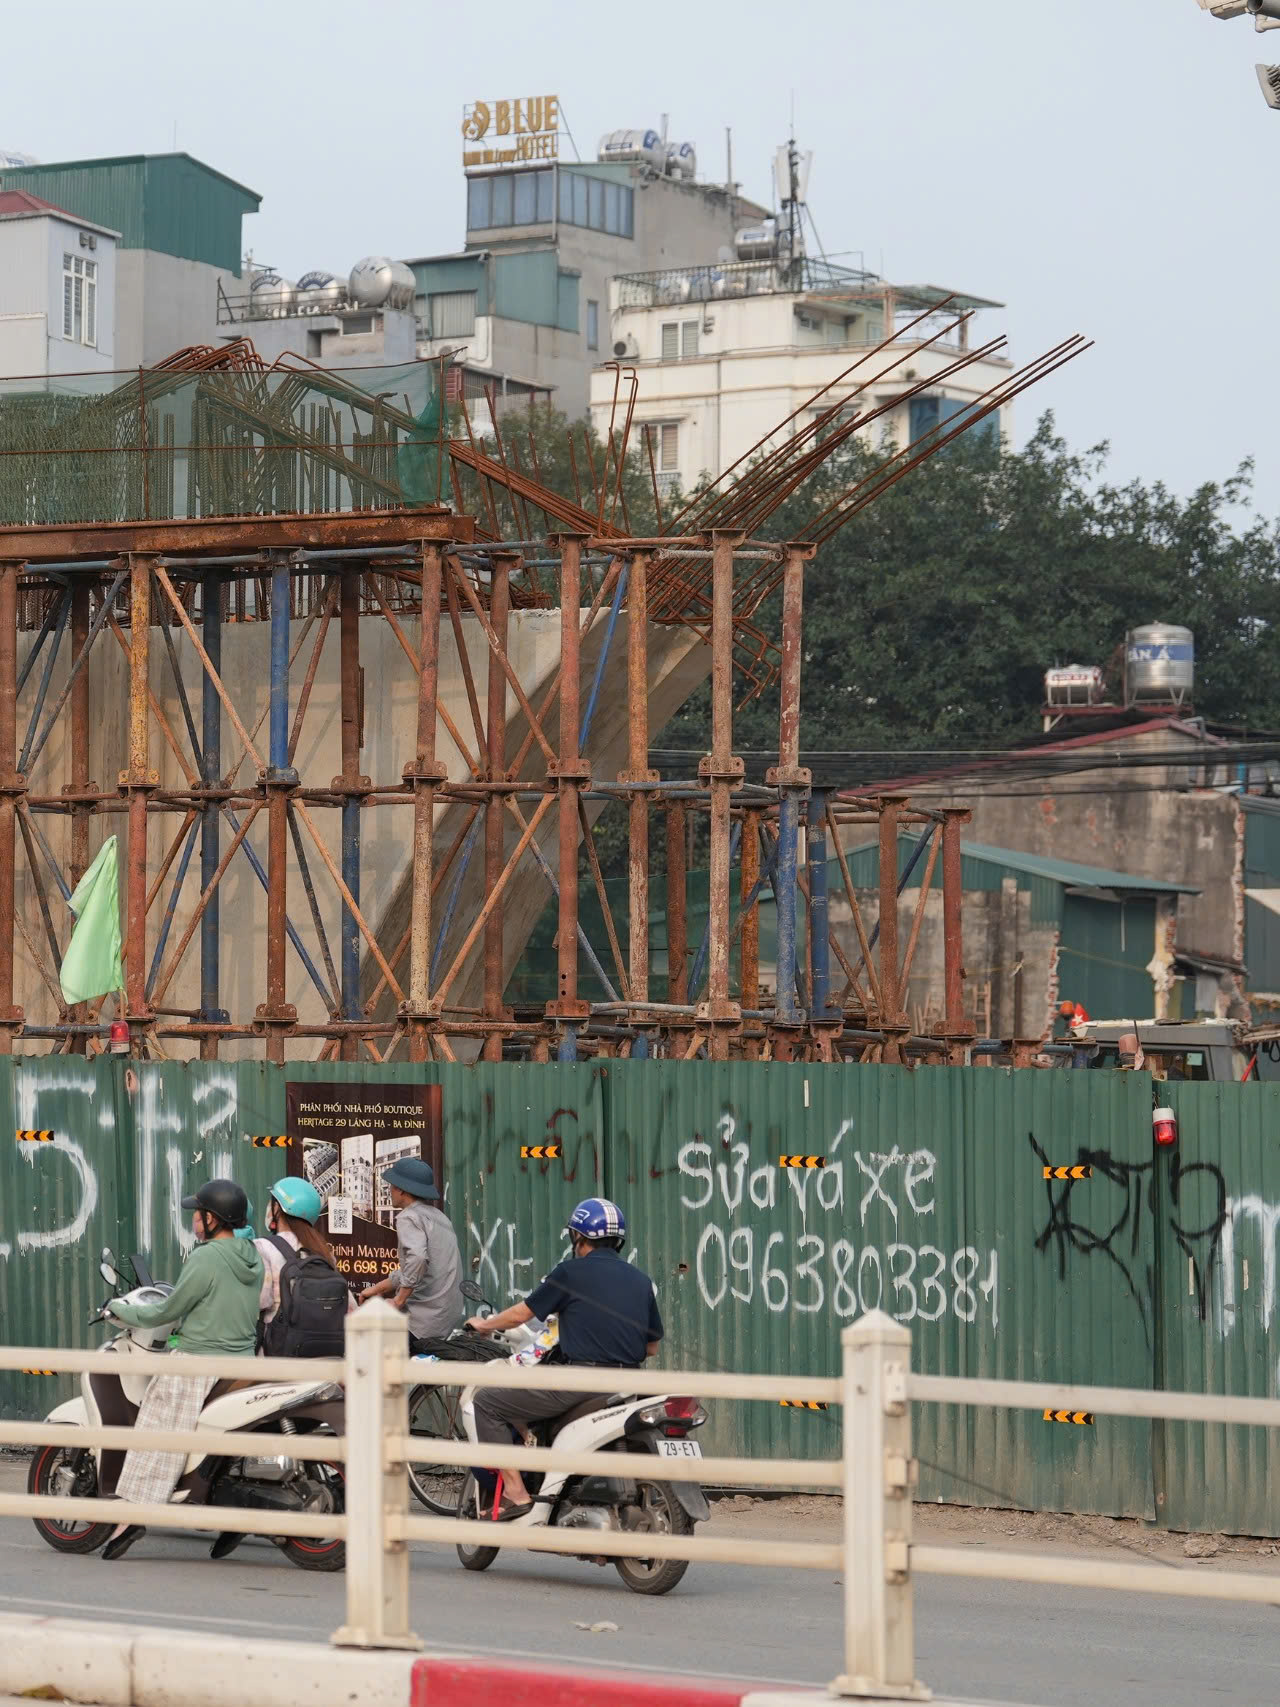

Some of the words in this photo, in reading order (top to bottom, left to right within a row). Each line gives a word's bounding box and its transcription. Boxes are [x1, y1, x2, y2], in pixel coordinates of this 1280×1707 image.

[496, 95, 557, 135] BLUE
[300, 1102, 321, 1112] PHÂN
[323, 1102, 342, 1113] PHỐI
[344, 1103, 362, 1113] NHÀ
[364, 1102, 381, 1114] PHỐ
[383, 1105, 423, 1116] BOUTIQUE
[297, 1117, 333, 1128] HERITAGE
[335, 1118, 347, 1127] 29
[393, 1120, 402, 1128] BA
[404, 1118, 426, 1129] ĐÌNH
[354, 1260, 377, 1274] 698
[696, 1222, 1000, 1332] 0963803381
[664, 1442, 696, 1456] 29-E1
